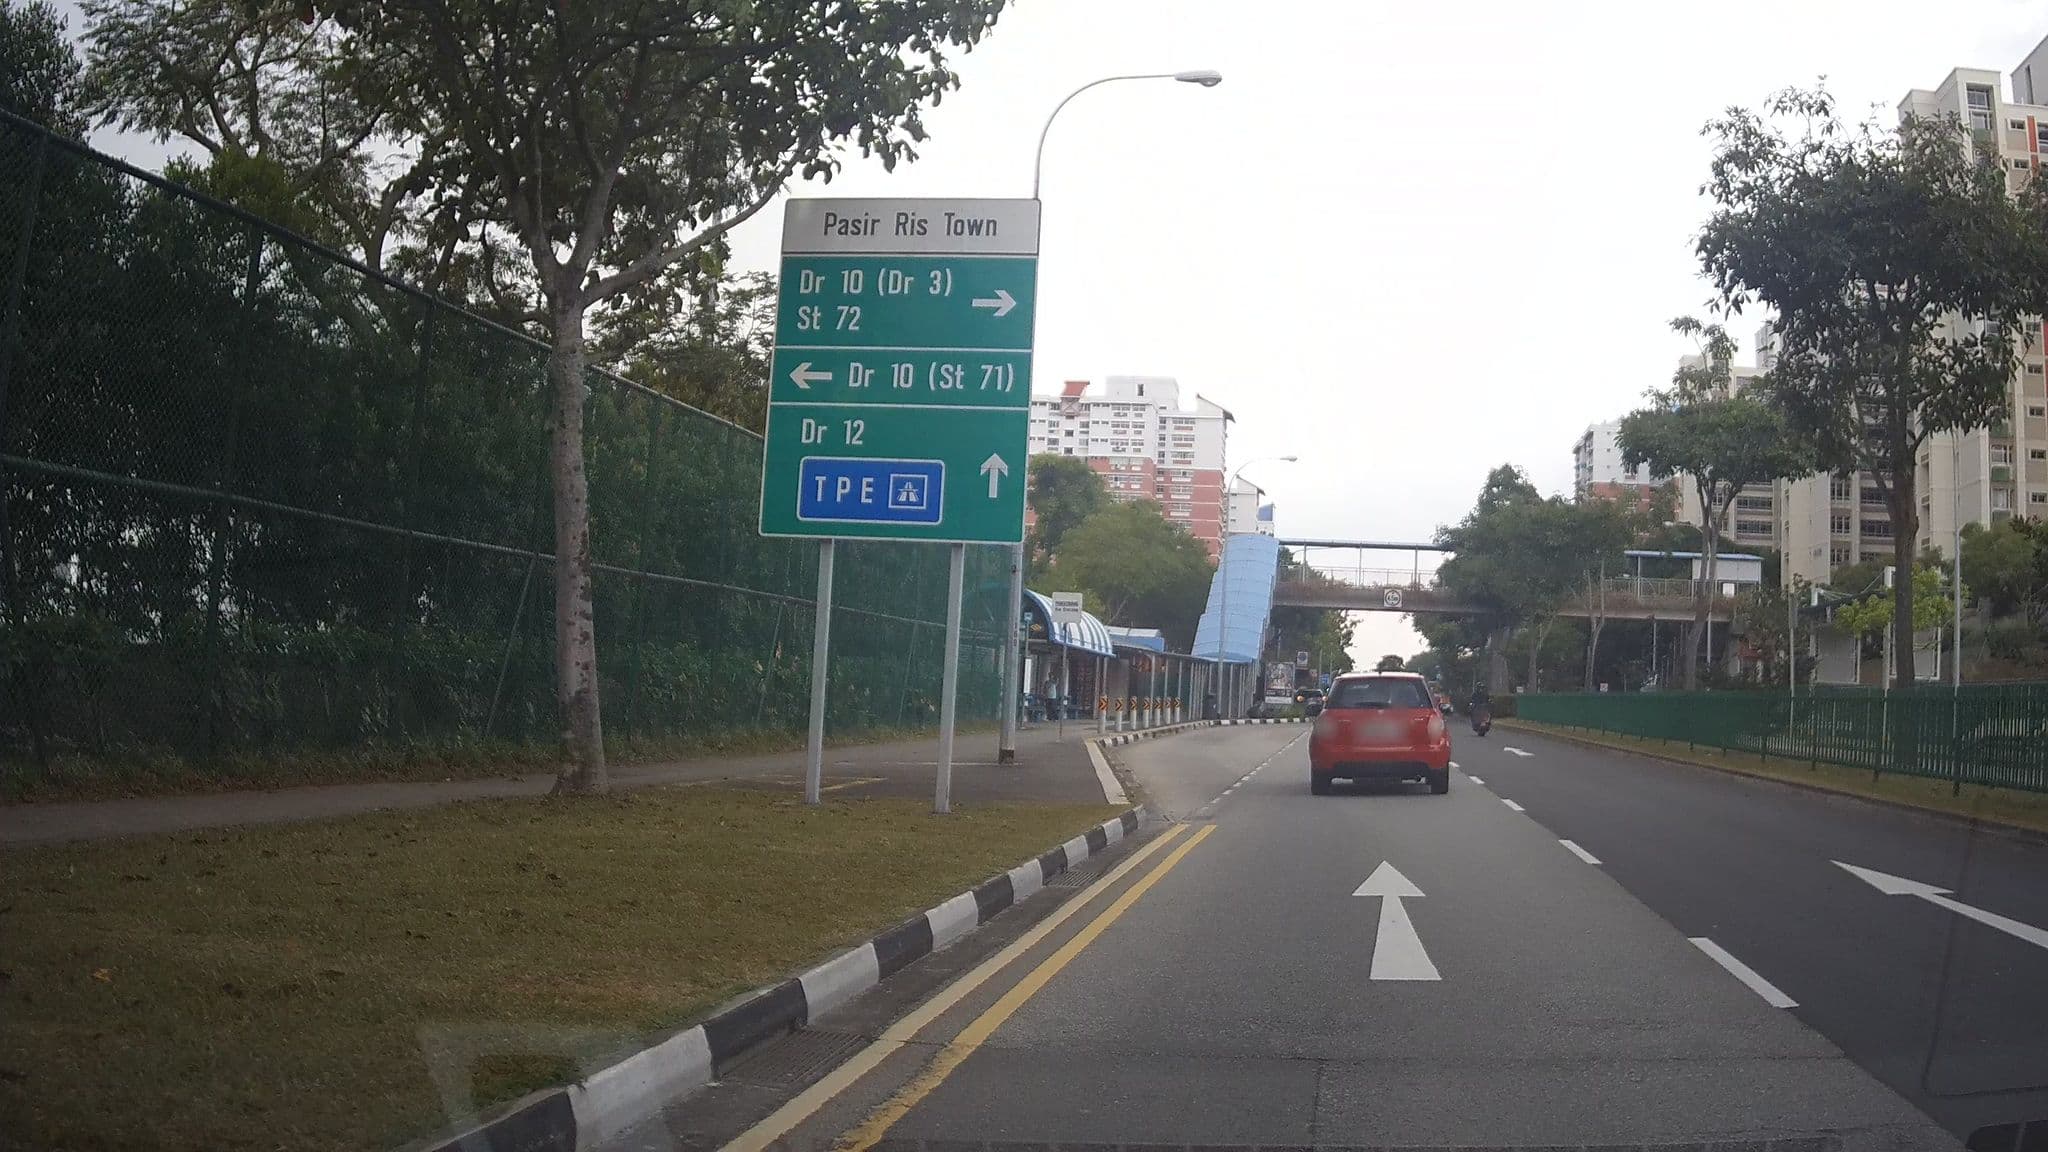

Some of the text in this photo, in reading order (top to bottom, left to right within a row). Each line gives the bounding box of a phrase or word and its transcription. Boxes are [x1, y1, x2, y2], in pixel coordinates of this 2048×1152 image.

[824, 212, 998, 236] Pasir Ris Town
[800, 267, 952, 296] Dr 10 (Dr 3)
[797, 306, 861, 331] St 72
[848, 361, 1014, 392] Dr 10 (St 71)
[801, 418, 865, 445] Dr 12
